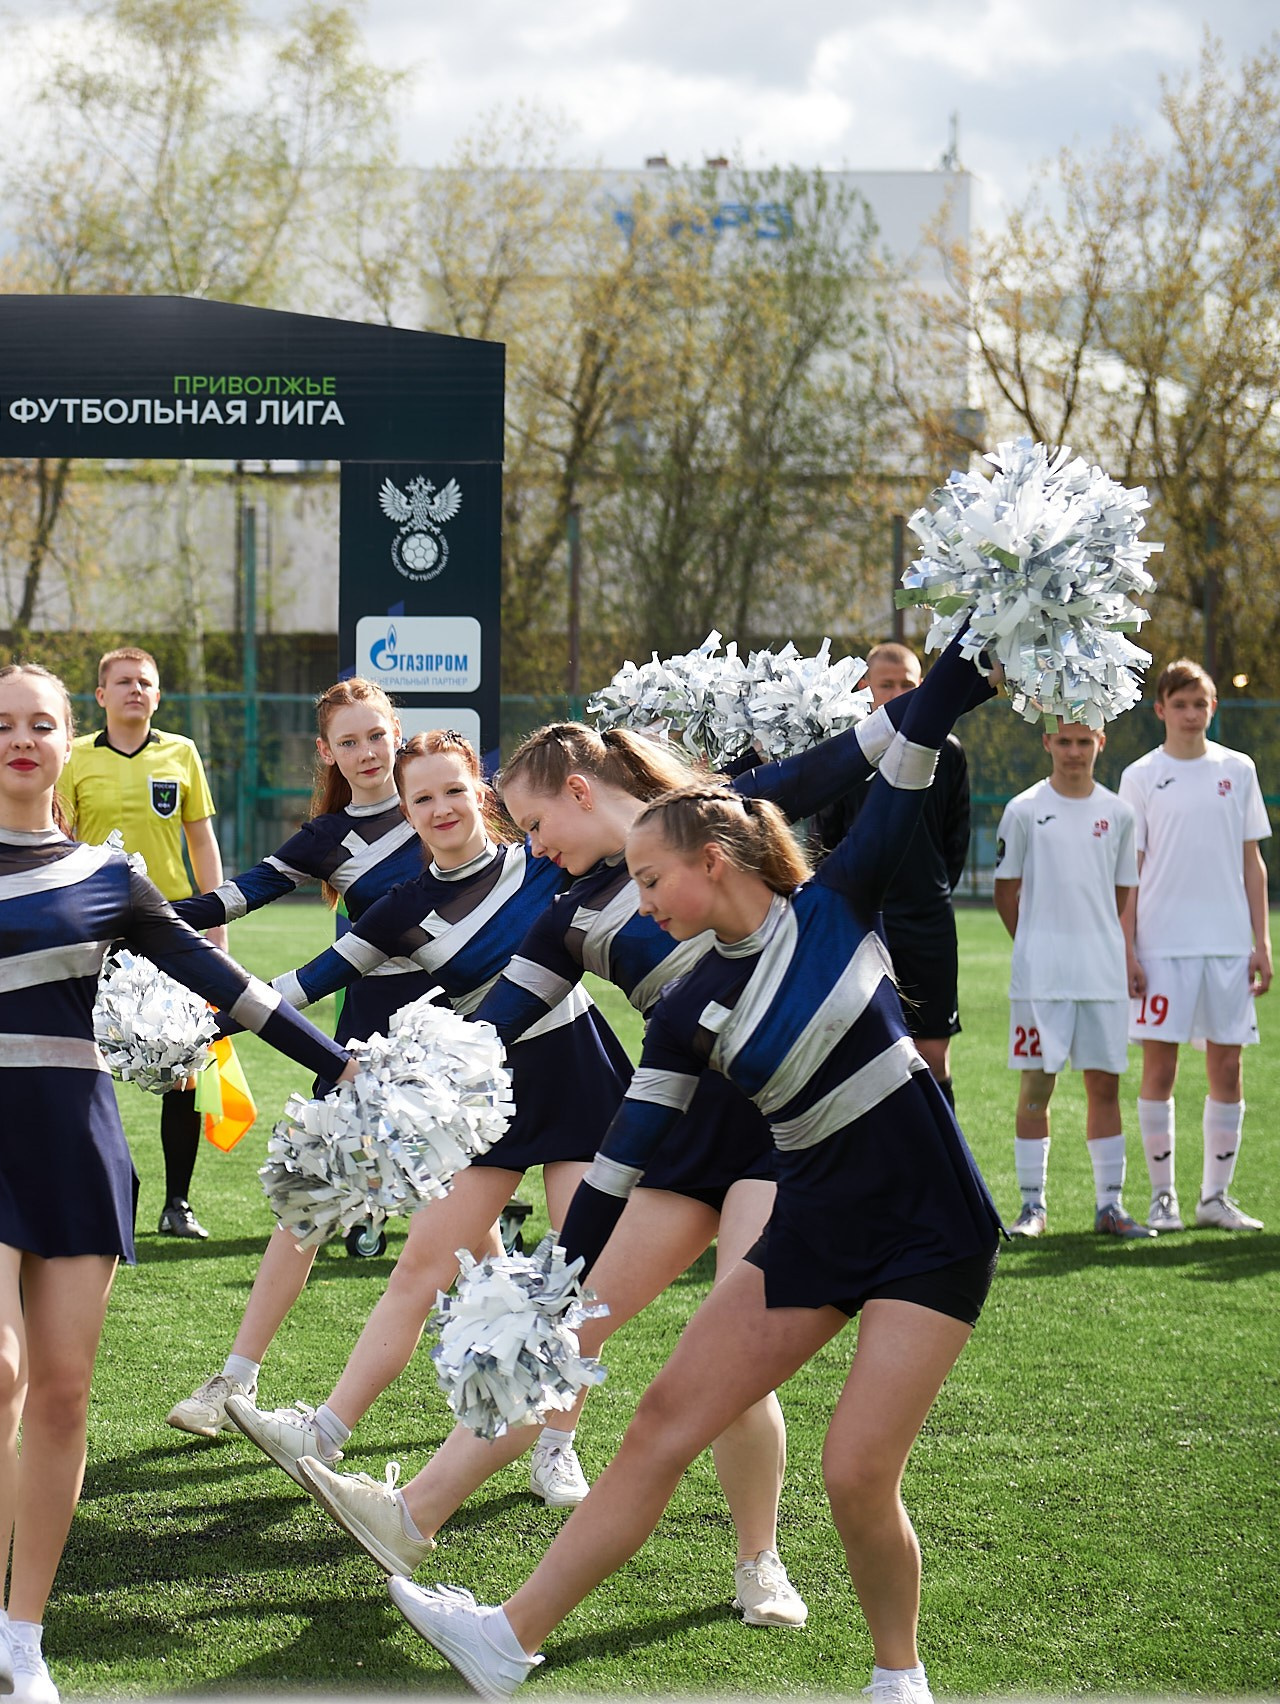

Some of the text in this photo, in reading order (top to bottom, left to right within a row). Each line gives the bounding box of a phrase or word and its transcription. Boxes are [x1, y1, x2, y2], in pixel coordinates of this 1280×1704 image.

[173, 375, 337, 395] ПРИВОЛЖЬЕ
[9, 398, 247, 425] ФУТБОЛЬНАЯ
[255, 399, 346, 426] ЛИГА
[399, 653, 469, 672] ГАЗПРОМ
[431, 677, 469, 686] ПАРТНЕР
[1136, 993, 1169, 1027] 19
[1013, 1025, 1042, 1058] 22
